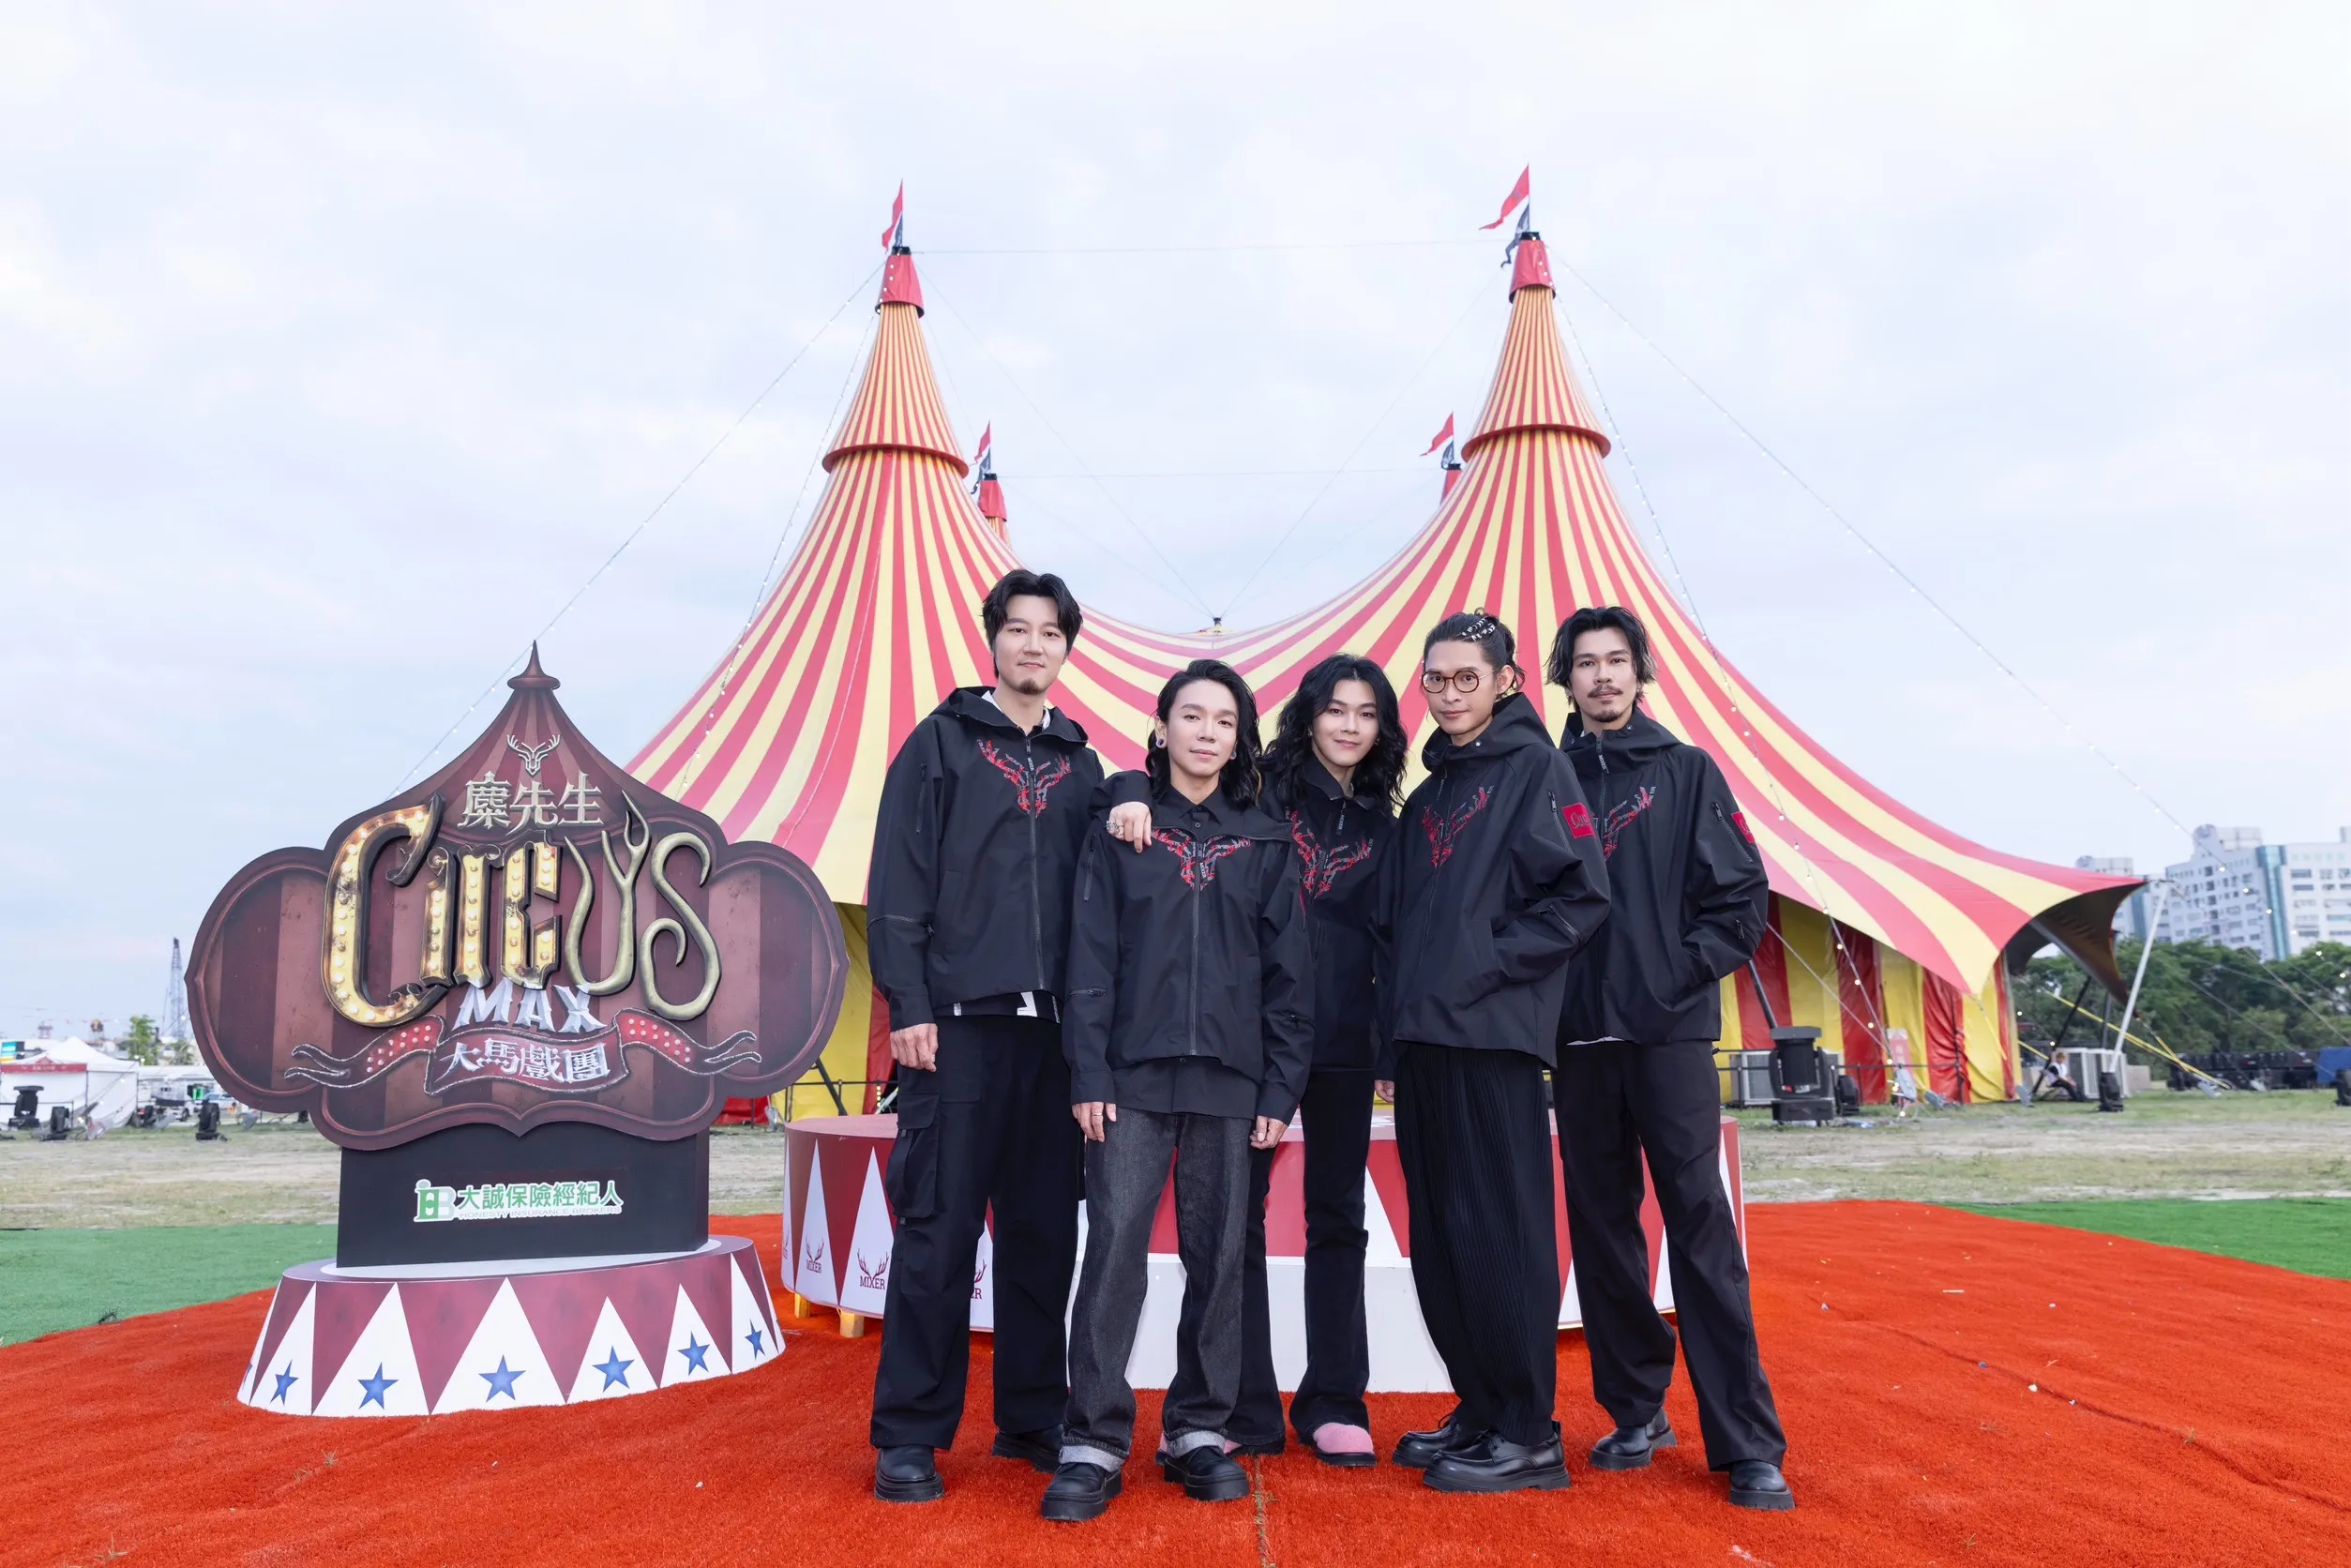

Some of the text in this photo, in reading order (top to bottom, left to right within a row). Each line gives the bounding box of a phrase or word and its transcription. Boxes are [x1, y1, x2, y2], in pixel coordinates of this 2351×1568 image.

[457, 770, 605, 836] 麋先生
[451, 976, 608, 1033] MAX
[434, 1037, 610, 1084] 大馬戲團
[458, 1181, 623, 1211] 大誠保險經紀人
[460, 1206, 622, 1219] HONESTY INSURANCE BROKERS
[859, 1275, 885, 1290] MIXER
